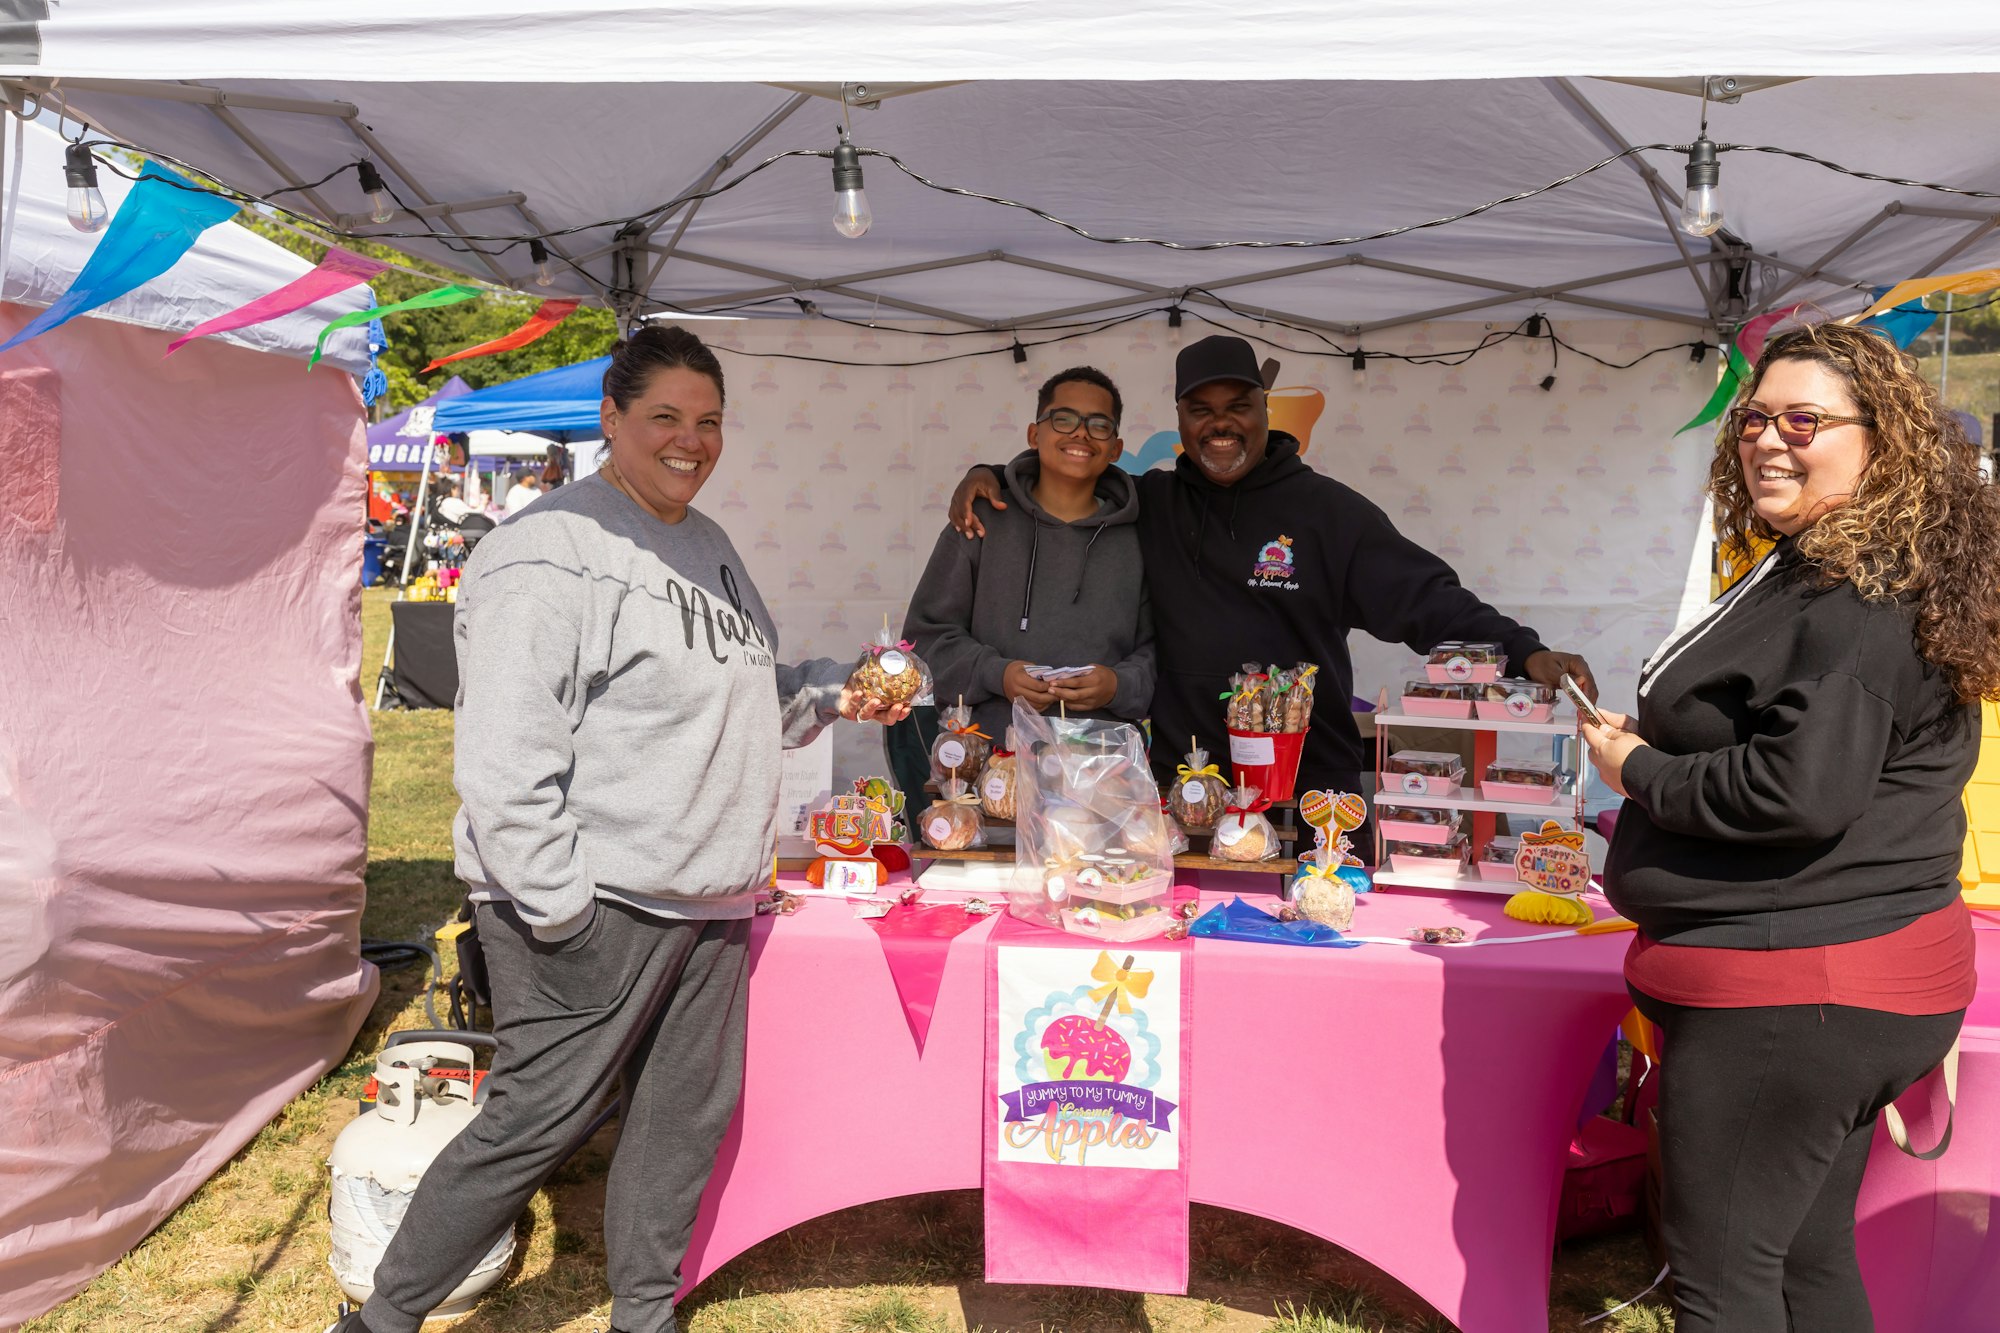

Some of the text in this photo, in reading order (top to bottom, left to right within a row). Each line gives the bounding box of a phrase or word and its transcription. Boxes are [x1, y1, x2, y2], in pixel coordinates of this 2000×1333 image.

[370, 444, 442, 464] OUGA
[832, 796, 866, 811] LET'S
[810, 809, 889, 839] FIESTA
[1540, 847, 1571, 861] HAPPY
[1520, 855, 1567, 874] CINCO
[1536, 872, 1571, 891] MAYO
[1026, 1086, 1147, 1110] YUMMY TO MY TUMMY
[1060, 1102, 1115, 1119] Caramel
[1004, 1100, 1159, 1166] Apples
